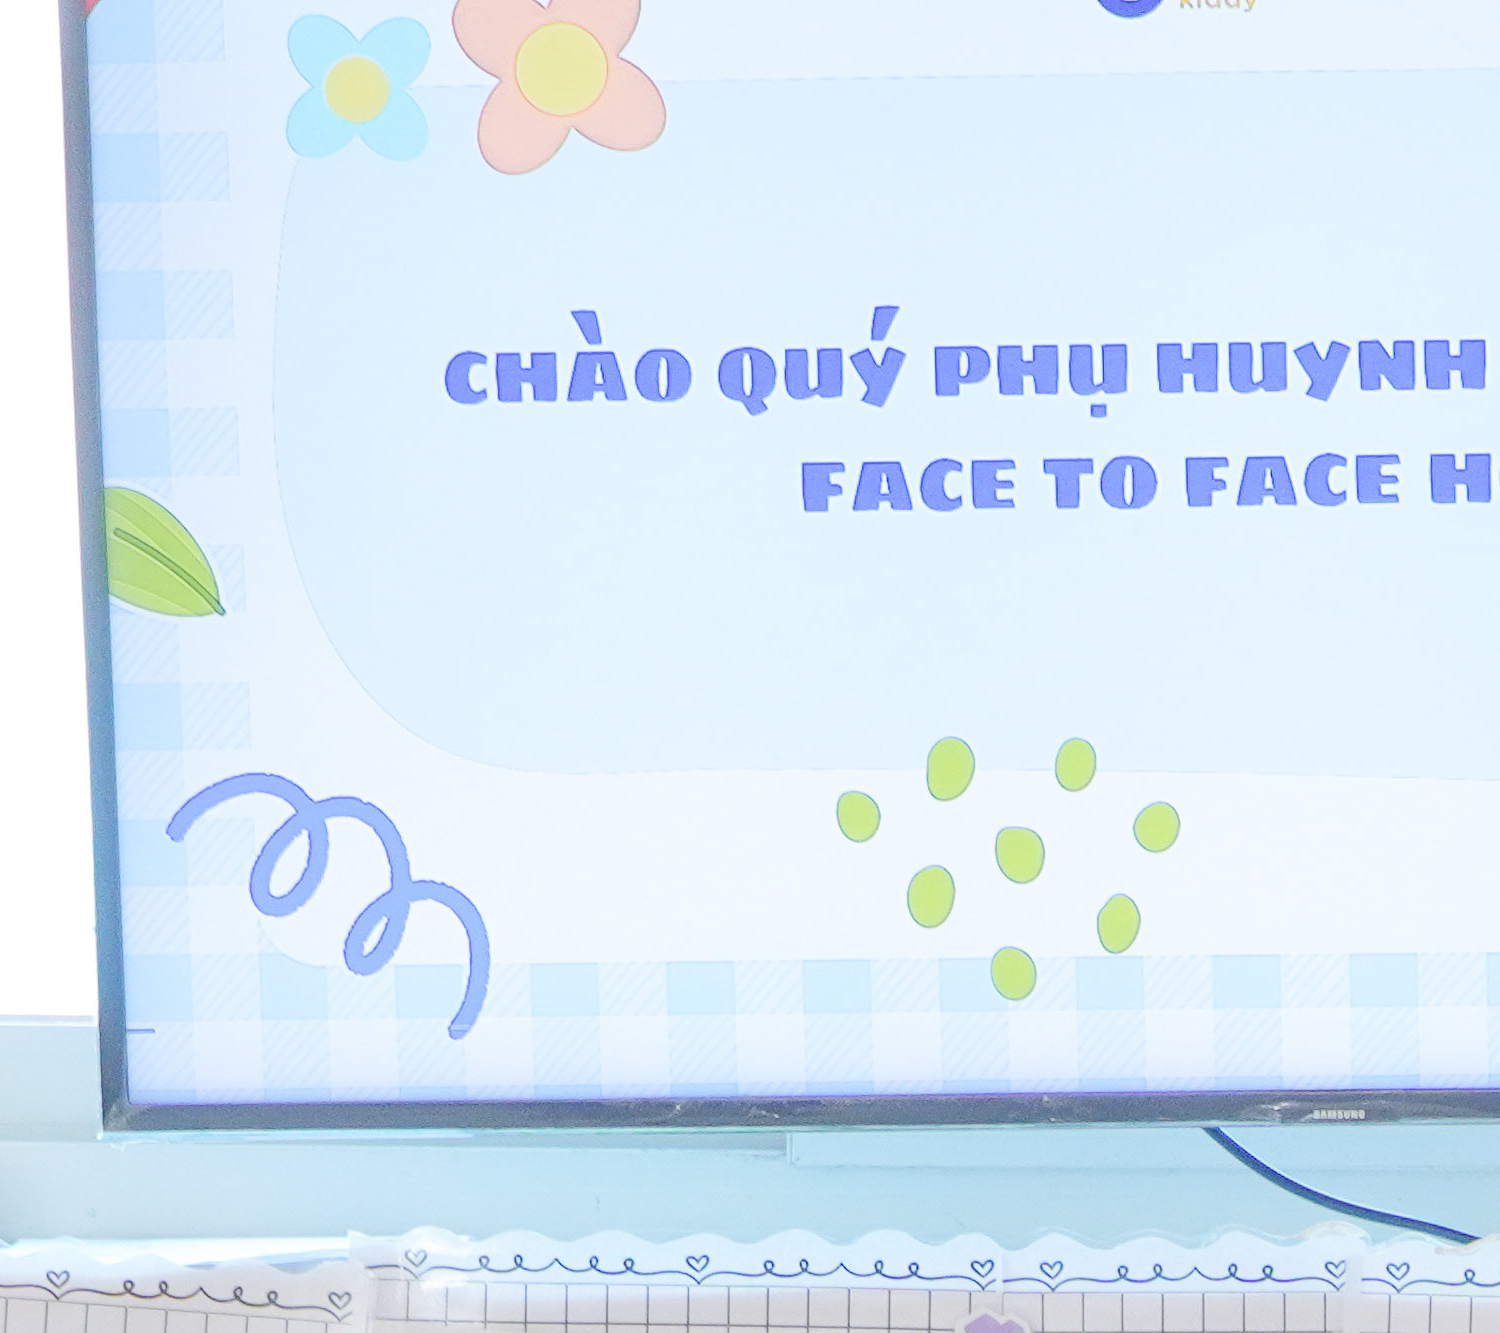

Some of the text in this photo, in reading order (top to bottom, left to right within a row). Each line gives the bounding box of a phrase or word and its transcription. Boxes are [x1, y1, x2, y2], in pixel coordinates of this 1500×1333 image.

[445, 310, 692, 405] CHÀO
[717, 305, 906, 416] QUÝ
[934, 343, 1127, 418] PHỤ
[1157, 334, 1485, 404] HUYNH
[802, 457, 1016, 513] FACE
[1043, 454, 1158, 509] TO
[1184, 449, 1405, 508] FACE
